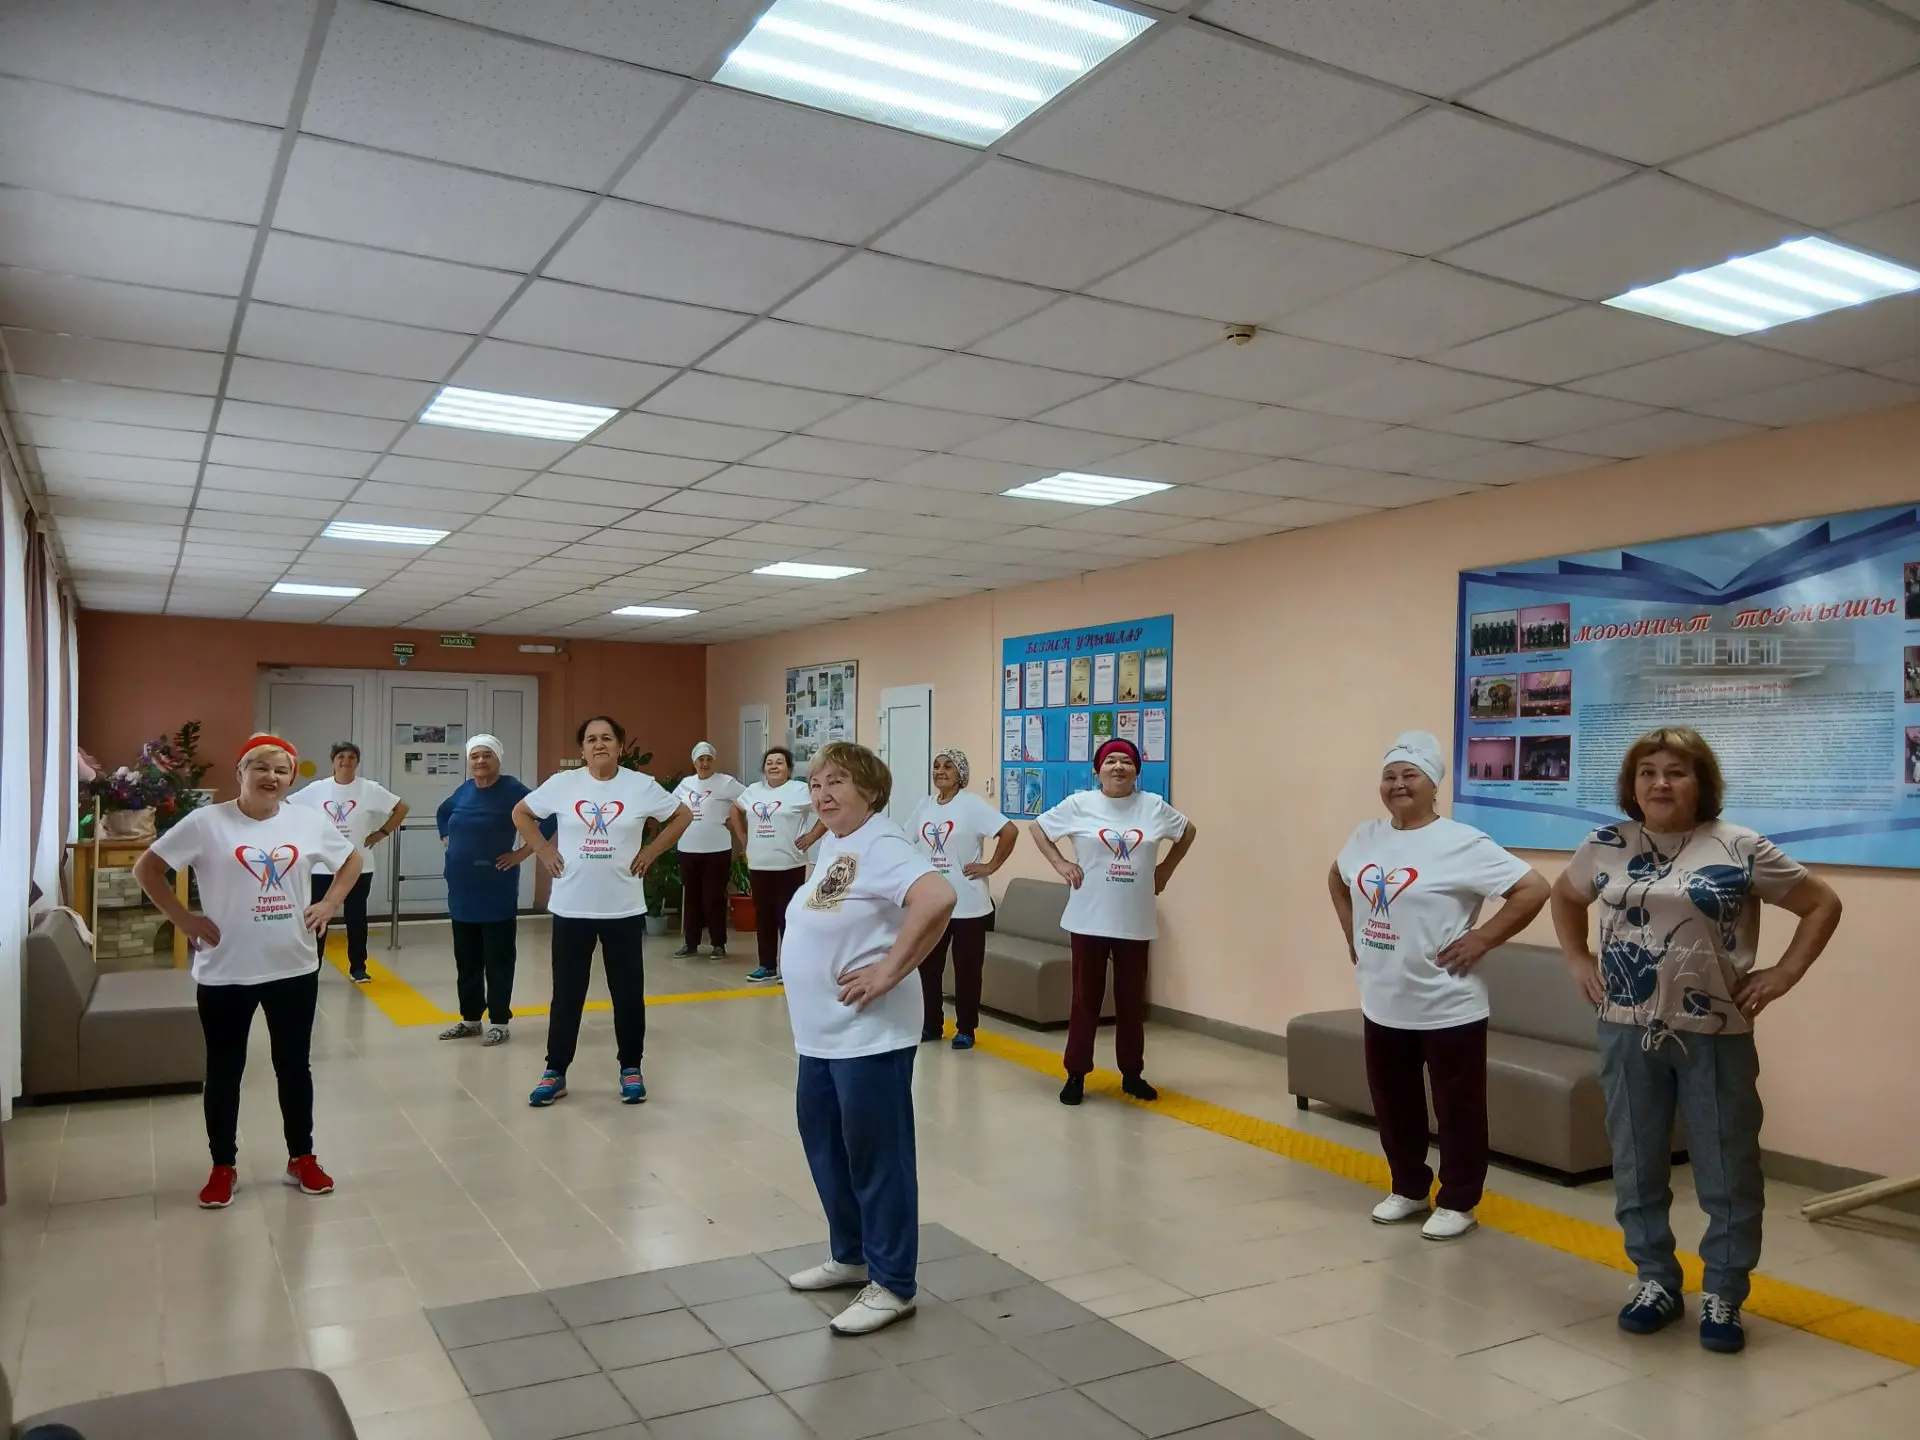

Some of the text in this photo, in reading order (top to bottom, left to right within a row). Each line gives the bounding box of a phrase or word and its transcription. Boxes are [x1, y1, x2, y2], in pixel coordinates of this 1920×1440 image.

[1731, 597, 1897, 630] ТОРМЫШЫ
[443, 637, 472, 646] ВЫХОД
[257, 895, 286, 904] Группа
[1368, 918, 1391, 930] Группа
